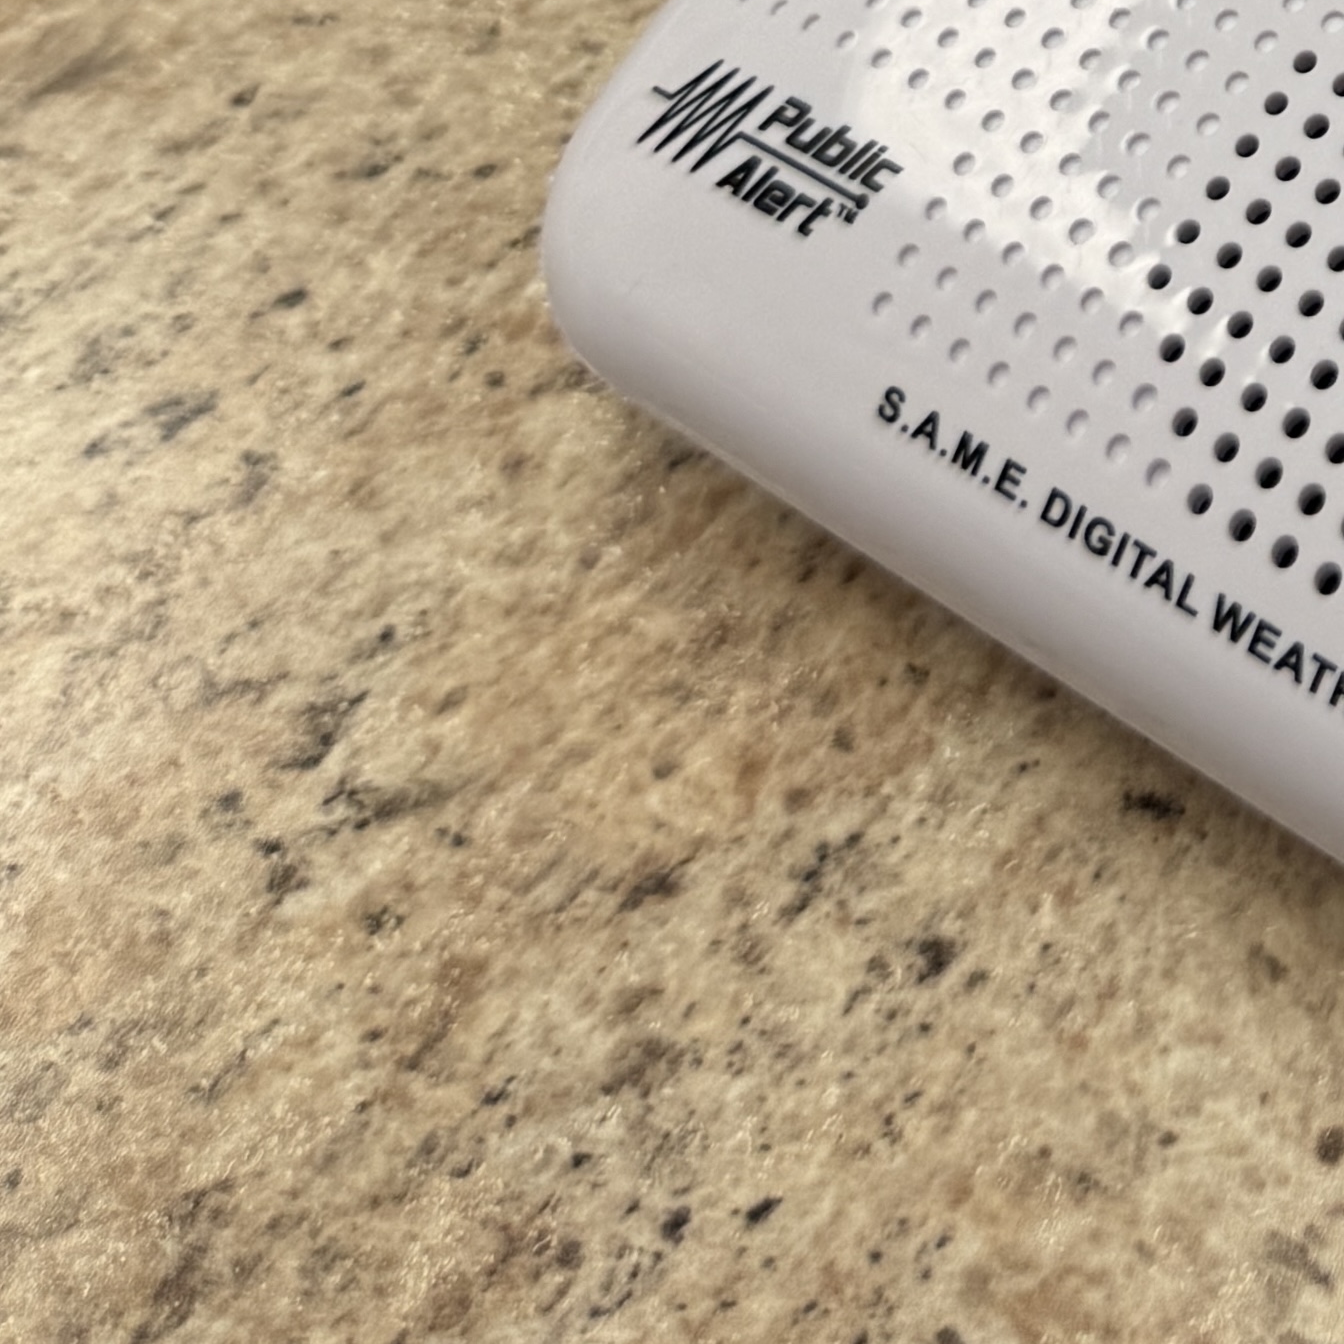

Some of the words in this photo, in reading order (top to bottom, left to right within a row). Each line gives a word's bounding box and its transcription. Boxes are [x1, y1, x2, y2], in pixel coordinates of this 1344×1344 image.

[757, 95, 905, 194] Public
[876, 385, 1030, 510] S.A.M.E.
[1039, 486, 1200, 617] DIGITAL
